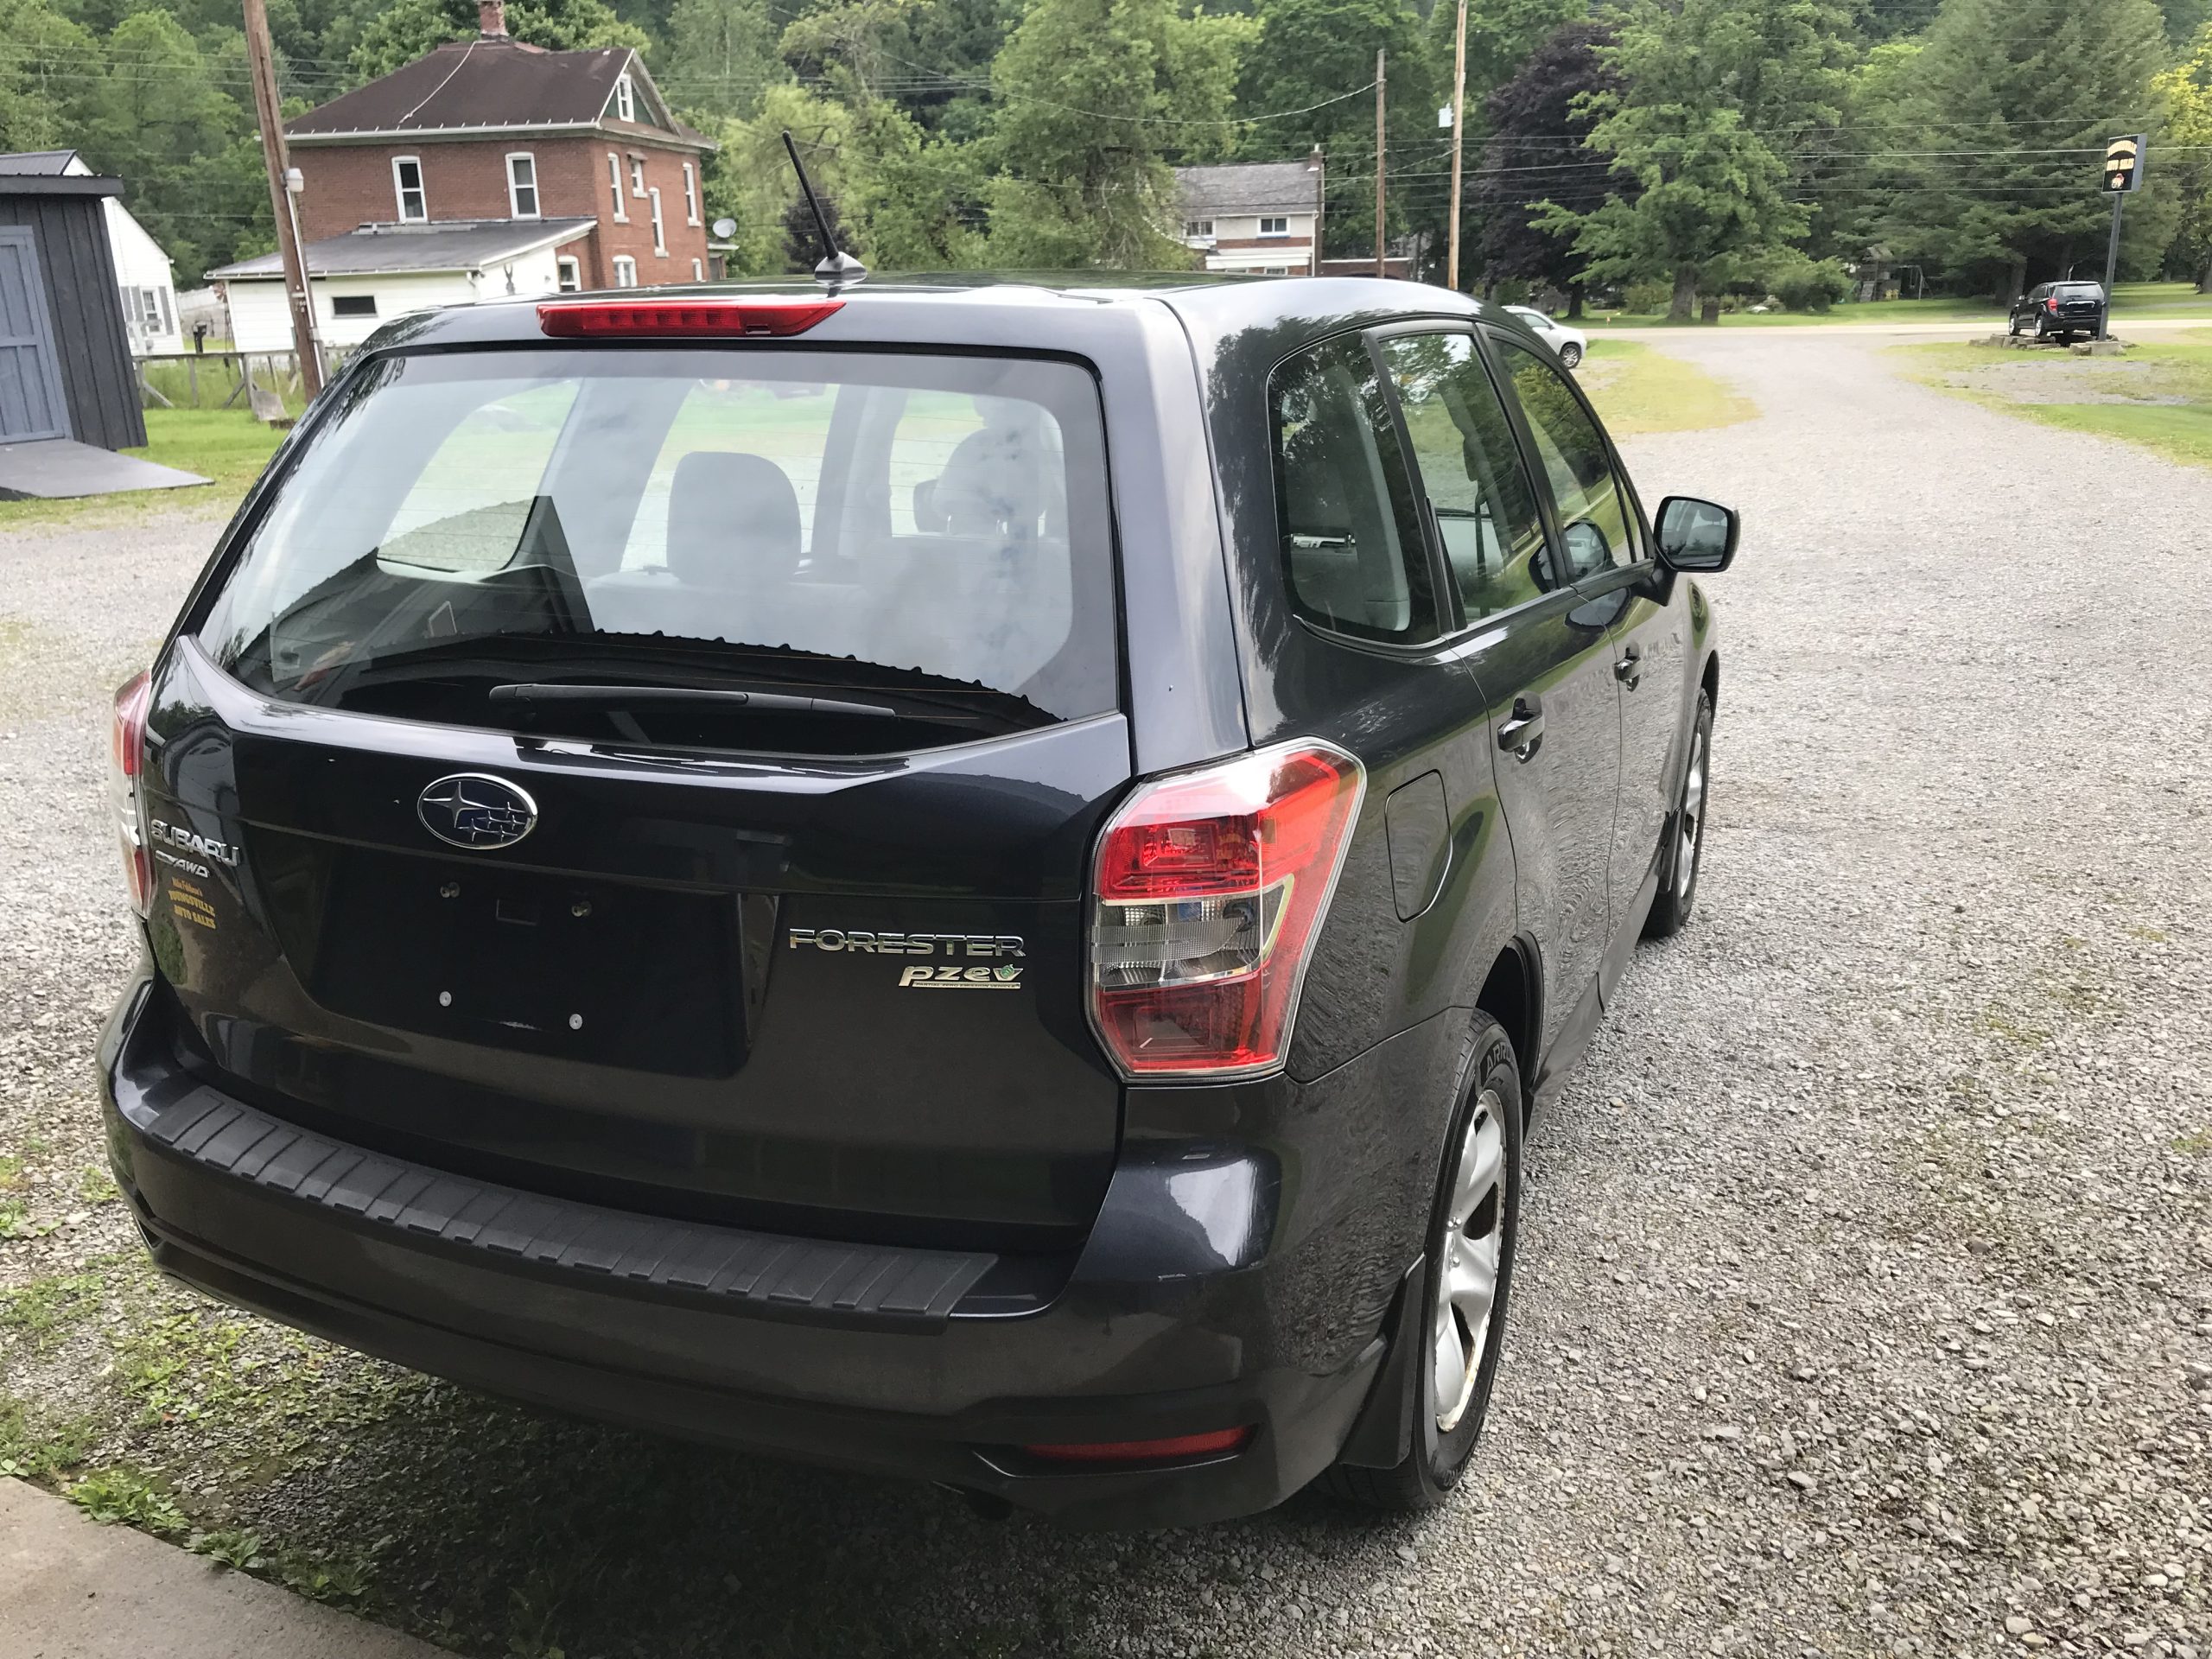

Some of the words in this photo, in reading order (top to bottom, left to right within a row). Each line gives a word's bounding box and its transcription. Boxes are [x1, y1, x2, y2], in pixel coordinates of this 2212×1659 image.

[151, 819, 240, 867] SUBARU
[174, 859, 210, 879] AWD
[192, 912, 216, 930] SALES
[790, 928, 1027, 957] FORESTER
